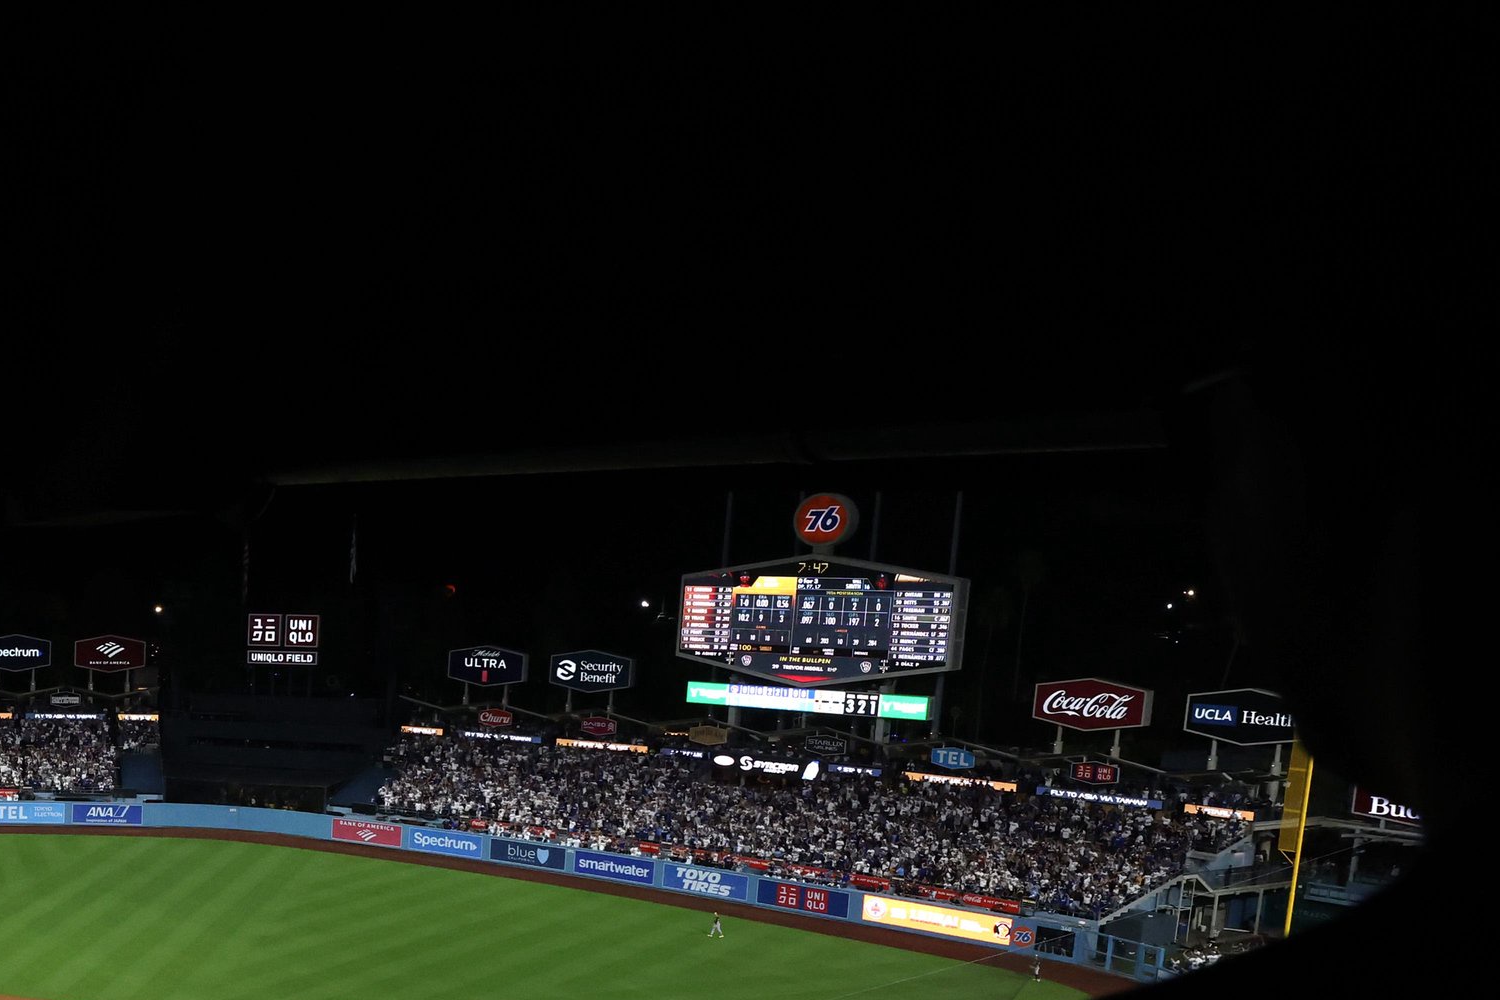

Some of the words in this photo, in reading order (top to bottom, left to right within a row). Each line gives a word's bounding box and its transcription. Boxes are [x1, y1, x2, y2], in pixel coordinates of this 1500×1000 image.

[804, 505, 840, 533] 76
[798, 562, 829, 574] 7:47
[253, 618, 275, 630] ユニ
[759, 614, 763, 622] 9
[875, 619, 879, 627] 2
[290, 619, 312, 631] UNI
[252, 631, 275, 642] クロ
[289, 631, 314, 643] QLO
[251, 653, 283, 662] UNIQLO
[286, 654, 313, 663] FIELD
[464, 658, 506, 669] ULTRA
[580, 660, 623, 673] Security
[580, 673, 616, 684] Benefit
[846, 700, 854, 713] 3
[857, 700, 865, 714] 2
[870, 701, 875, 714] 1
[1043, 689, 1134, 720] Coca-Cola
[479, 712, 511, 724] Churu
[1194, 708, 1232, 722] UCLA
[808, 738, 844, 747] STARLUX
[937, 750, 969, 766] TEL
[1078, 792, 1097, 800] ASIA
[1115, 797, 1147, 806] TAIWAN
[87, 807, 113, 817] ANA
[366, 824, 394, 832] AMERICA
[413, 832, 472, 851] Spectrum
[507, 845, 535, 859] blue
[579, 858, 650, 878] smartwater
[676, 867, 722, 884] TOYO
[682, 879, 731, 897] TIRES
[806, 890, 825, 900] UNI
[806, 900, 826, 911] QLO
[1015, 931, 1031, 943] 76
